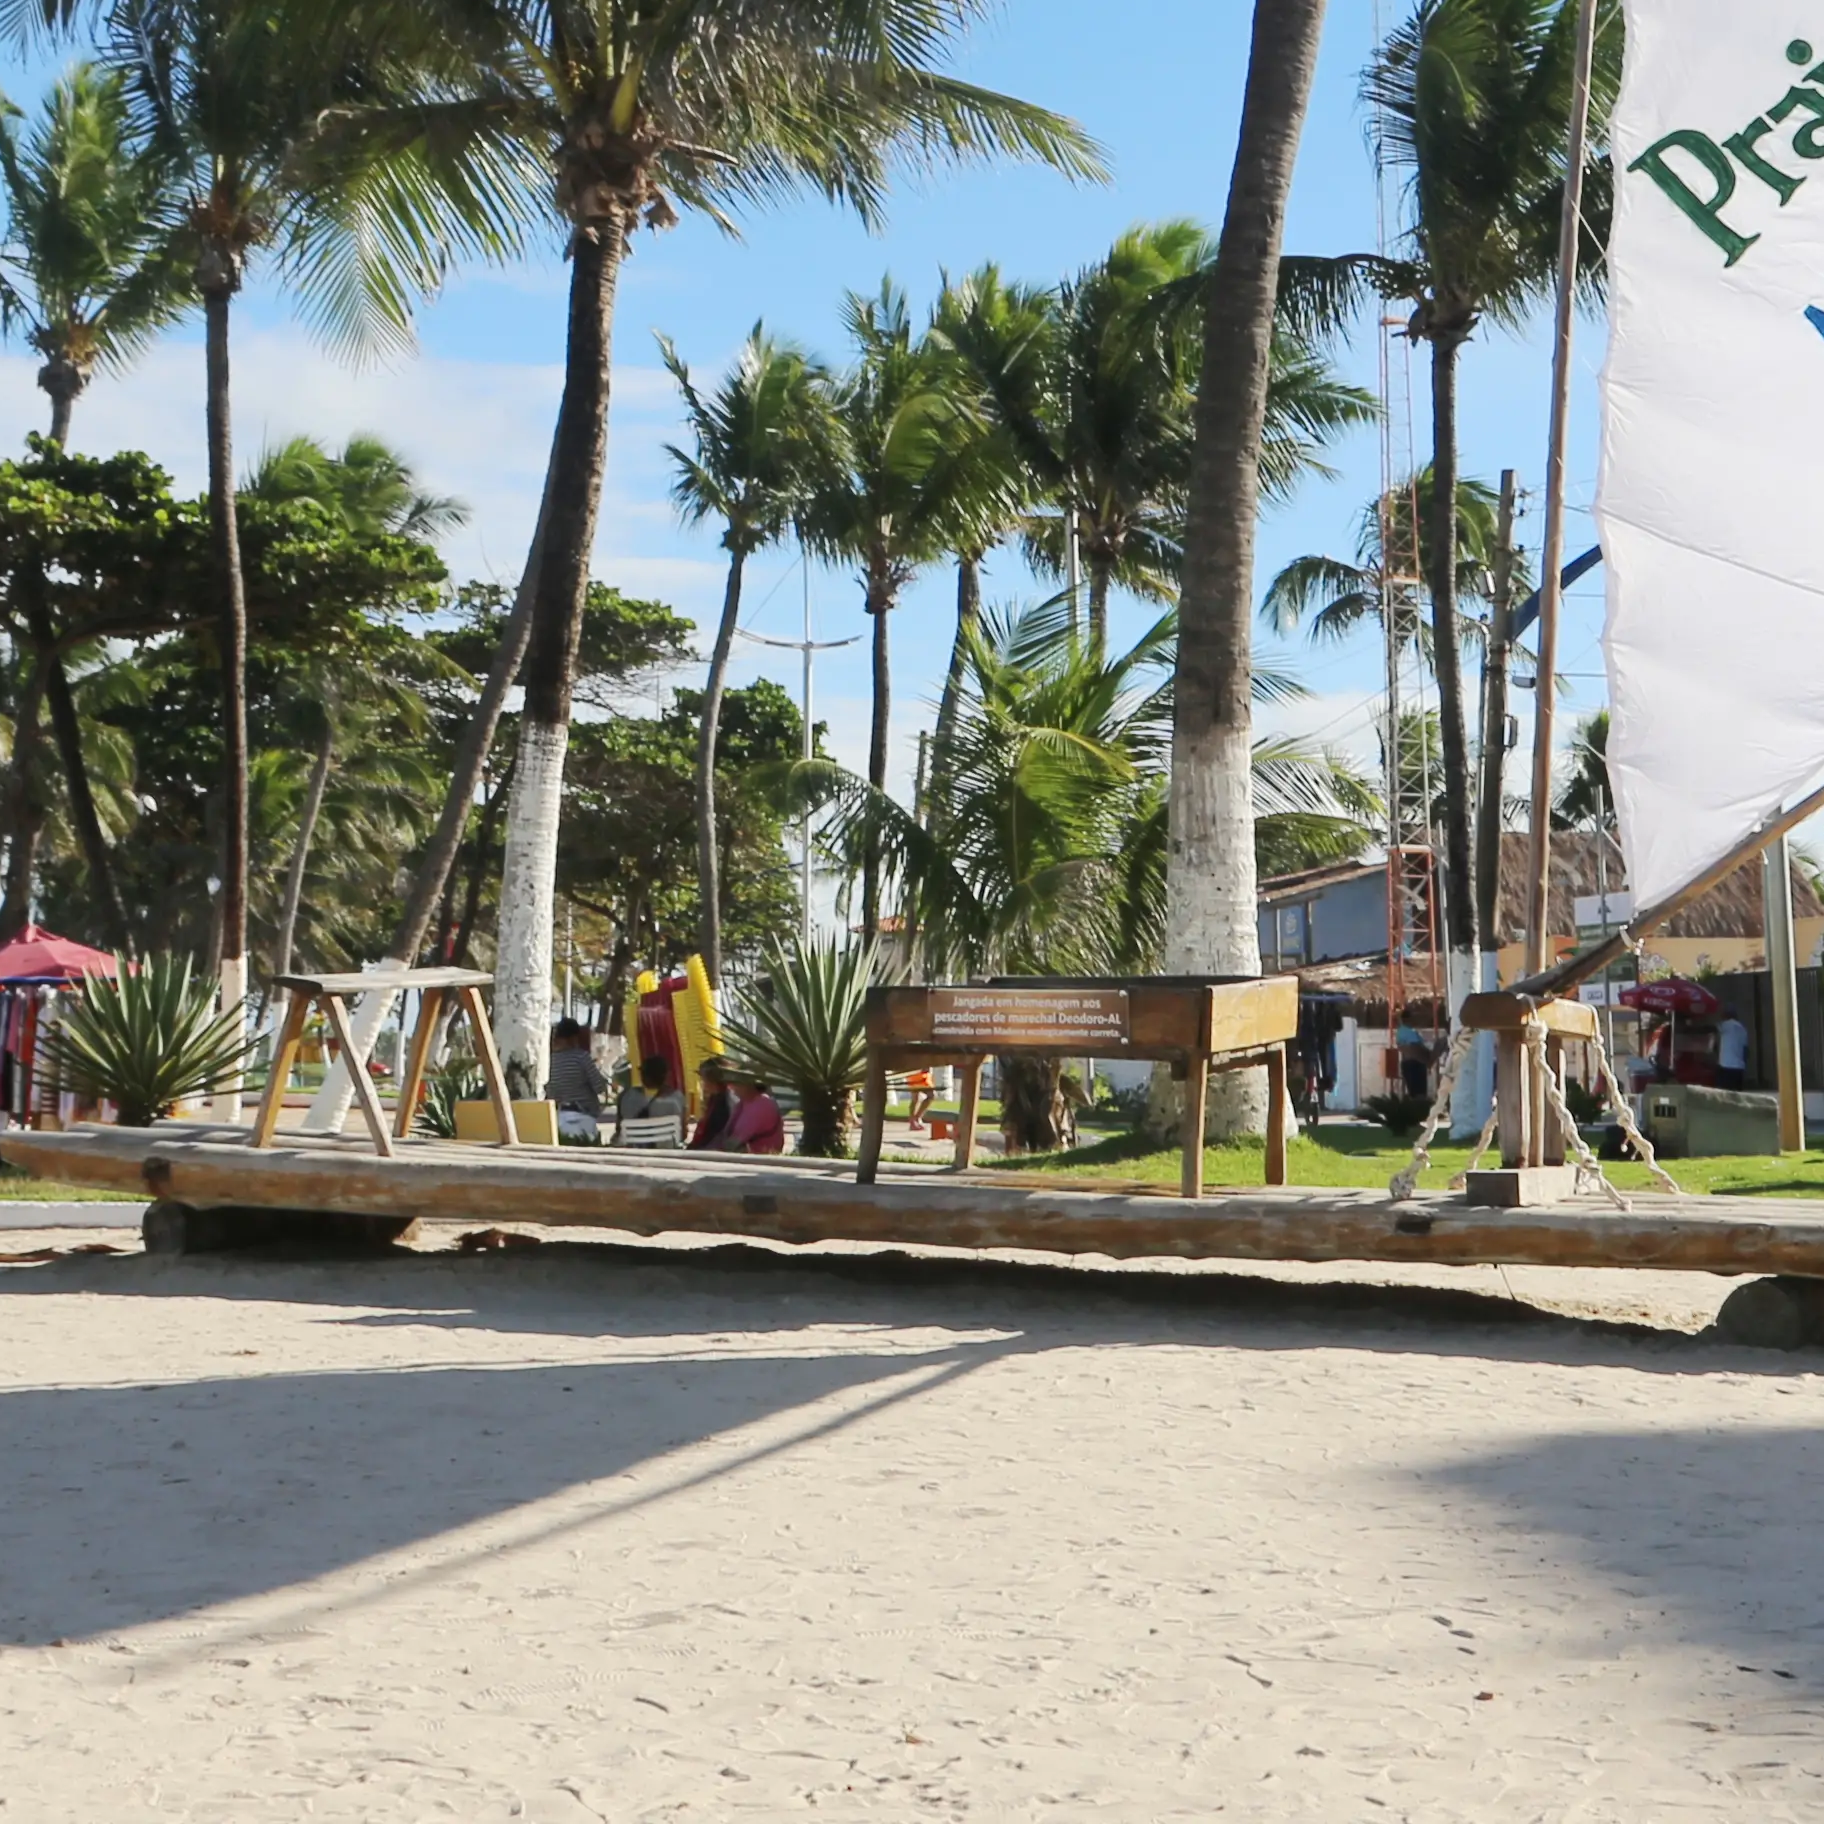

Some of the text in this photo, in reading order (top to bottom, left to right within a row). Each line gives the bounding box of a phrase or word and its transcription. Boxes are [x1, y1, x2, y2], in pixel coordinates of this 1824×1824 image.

[953, 996, 1101, 1010] Jangada em homenagem aos
[934, 1012, 1122, 1024] pescadores de marechal Deodoro-AL
